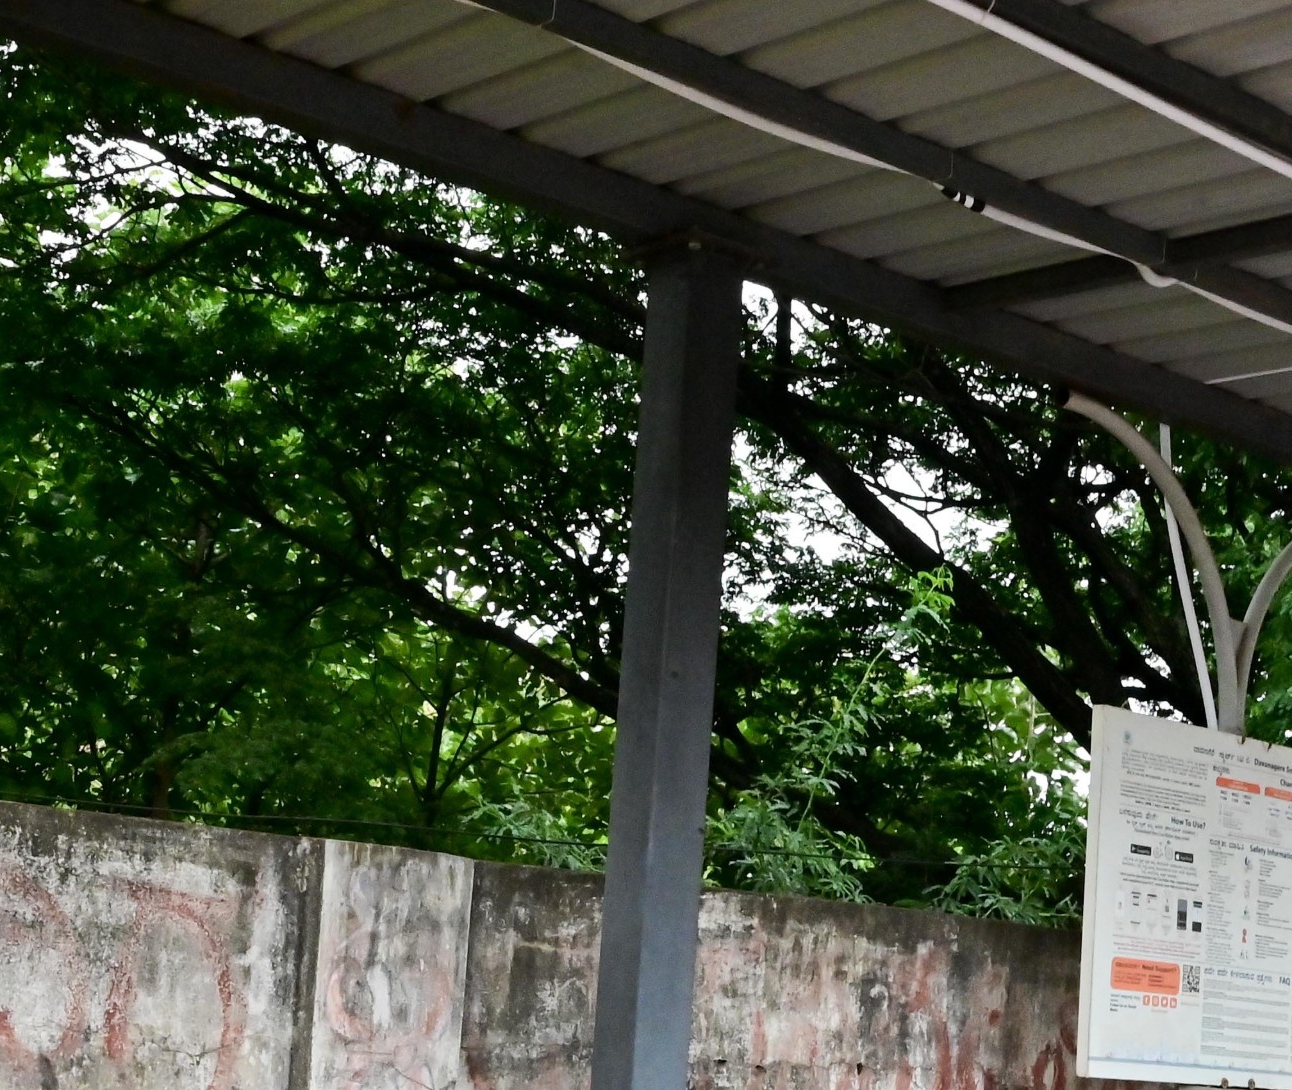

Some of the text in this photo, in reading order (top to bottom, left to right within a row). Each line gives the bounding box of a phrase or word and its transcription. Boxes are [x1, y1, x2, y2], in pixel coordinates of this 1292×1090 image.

[1171, 816, 1184, 826] How
[1185, 819, 1192, 827] To
[1193, 820, 1207, 830] Use?
[1250, 845, 1266, 856] Safety
